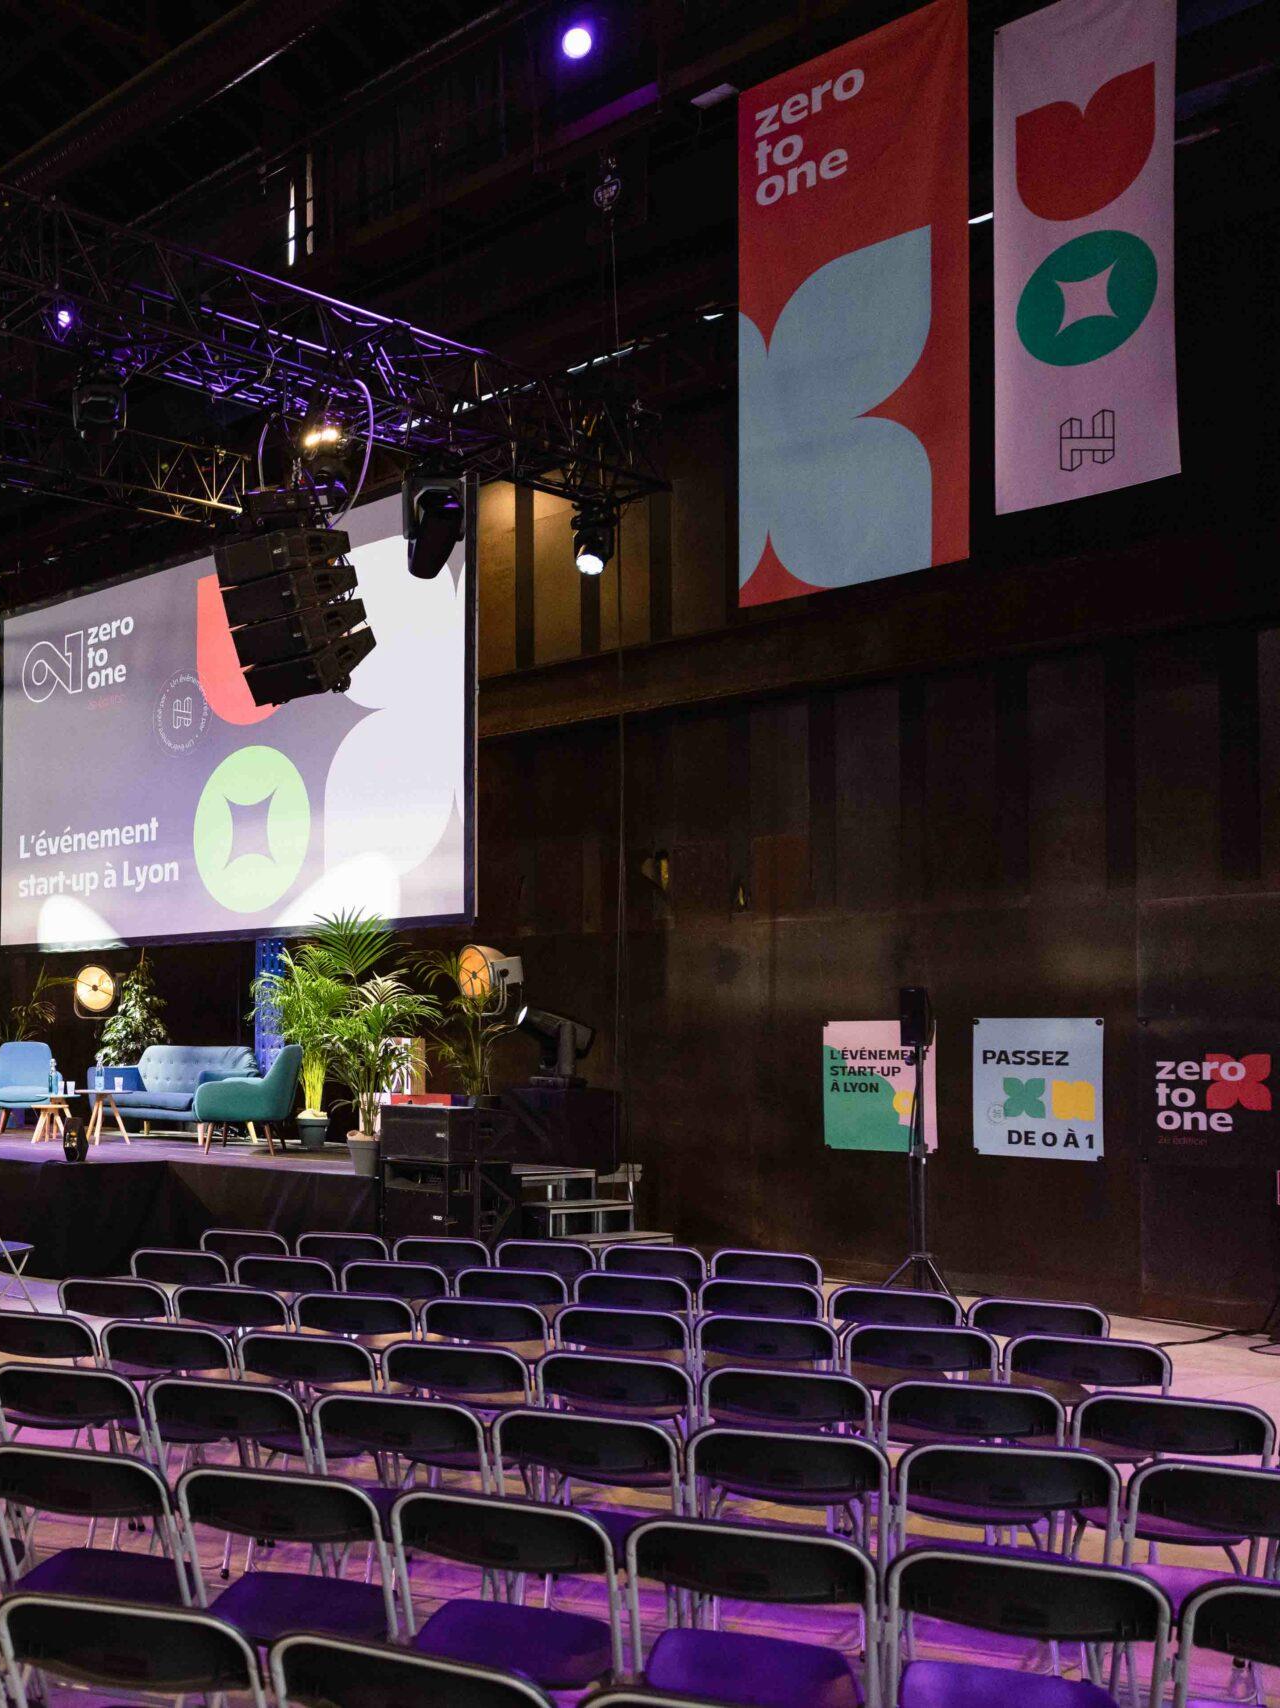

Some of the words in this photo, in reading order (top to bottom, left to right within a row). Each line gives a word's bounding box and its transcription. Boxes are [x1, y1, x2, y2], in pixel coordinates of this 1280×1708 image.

[755, 69, 865, 139] zero
[755, 134, 804, 175] to
[756, 149, 848, 205] one
[88, 616, 134, 645] zero
[88, 647, 108, 668] to
[87, 664, 127, 689] one
[19, 817, 159, 859] L'événement
[18, 870, 99, 898] start-up
[104, 862, 117, 888] à
[123, 861, 179, 893] Lyon
[982, 1050, 1070, 1067] PASSEZ
[830, 1066, 901, 1077] START-UP
[1155, 1061, 1247, 1081] zero
[831, 1080, 840, 1093] À
[843, 1083, 879, 1093] LYON
[1155, 1083, 1196, 1107] to
[1156, 1110, 1234, 1133] one
[1007, 1130, 1037, 1146] DE
[1063, 1128, 1080, 1149] À
[1085, 1134, 1095, 1150] 1
